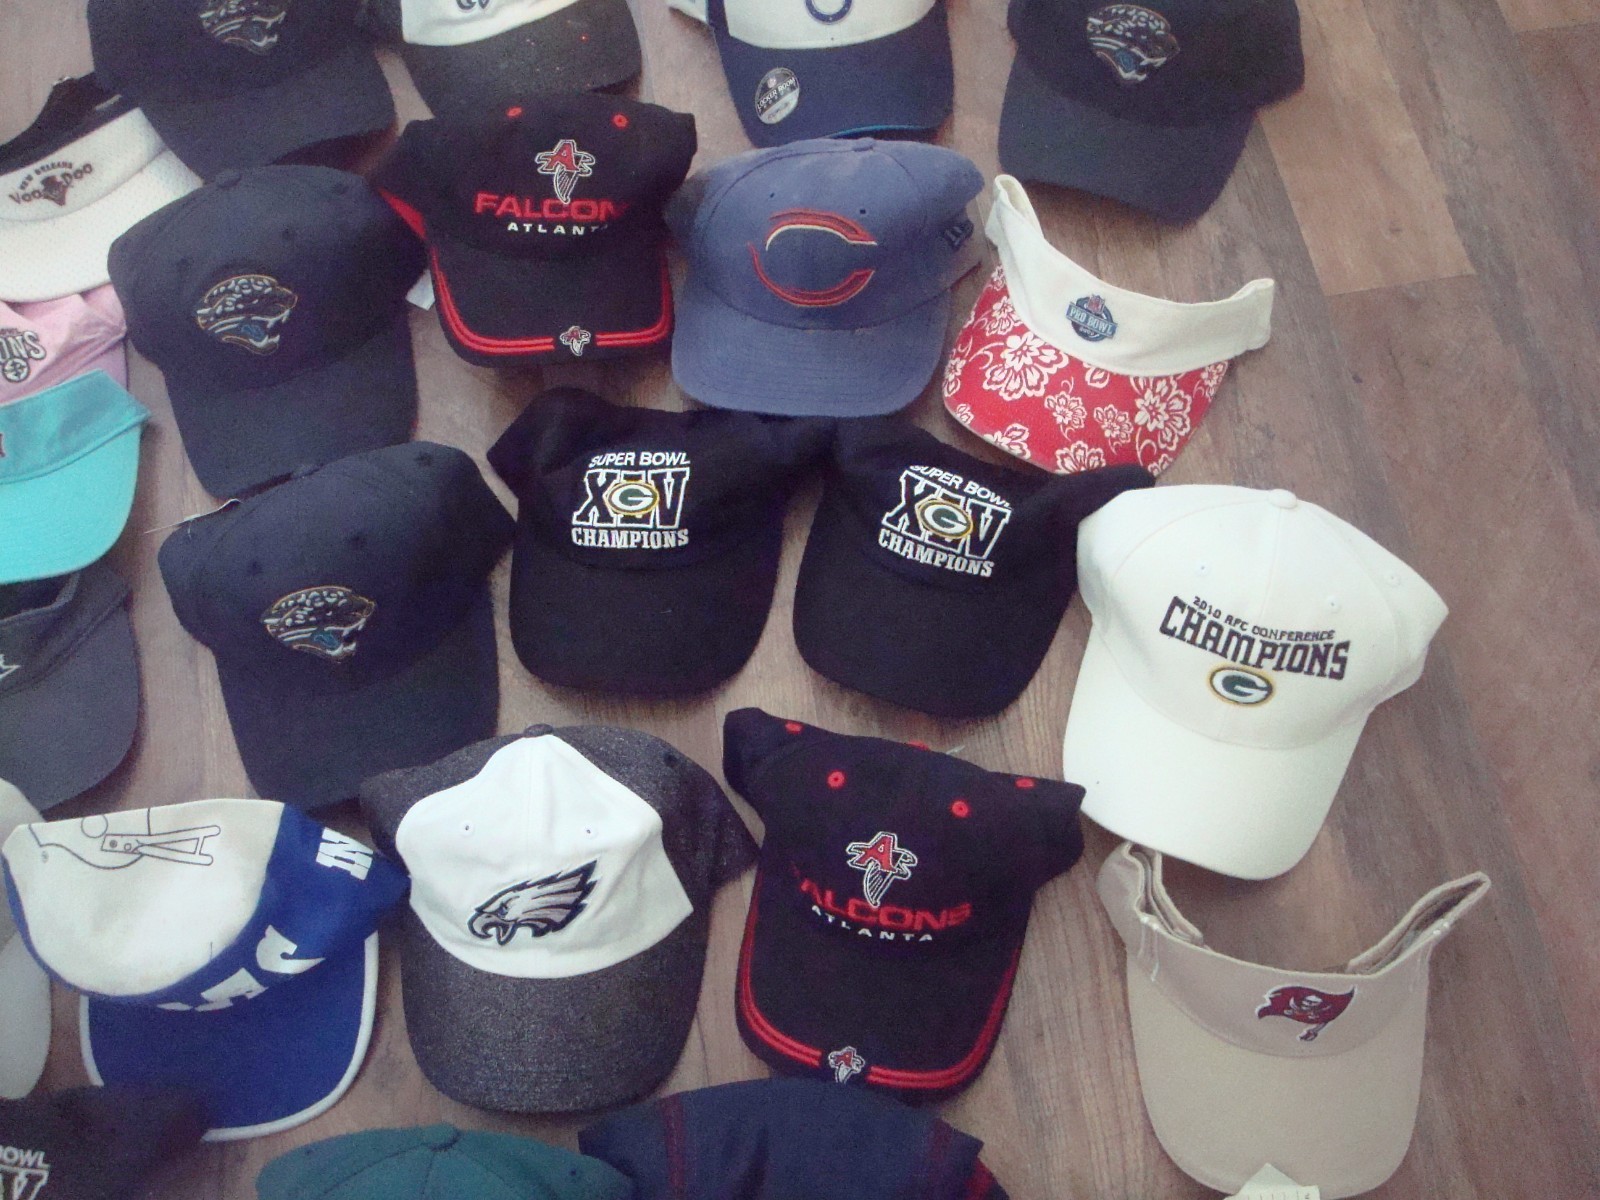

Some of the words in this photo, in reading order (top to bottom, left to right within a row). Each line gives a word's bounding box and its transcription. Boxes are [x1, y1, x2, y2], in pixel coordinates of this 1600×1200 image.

[473, 191, 628, 222] FALCON
[507, 222, 608, 236] ATLANT
[588, 452, 636, 468] SUPER
[639, 452, 691, 466] BOWL
[571, 528, 689, 549] CHAMPIONS
[878, 528, 995, 578] CHAMPIONS
[1193, 596, 1222, 619] 2010
[1251, 625, 1335, 641] CONFERENCE
[1159, 596, 1350, 681] CHAMPIONS
[811, 904, 933, 942] ATLANTA
